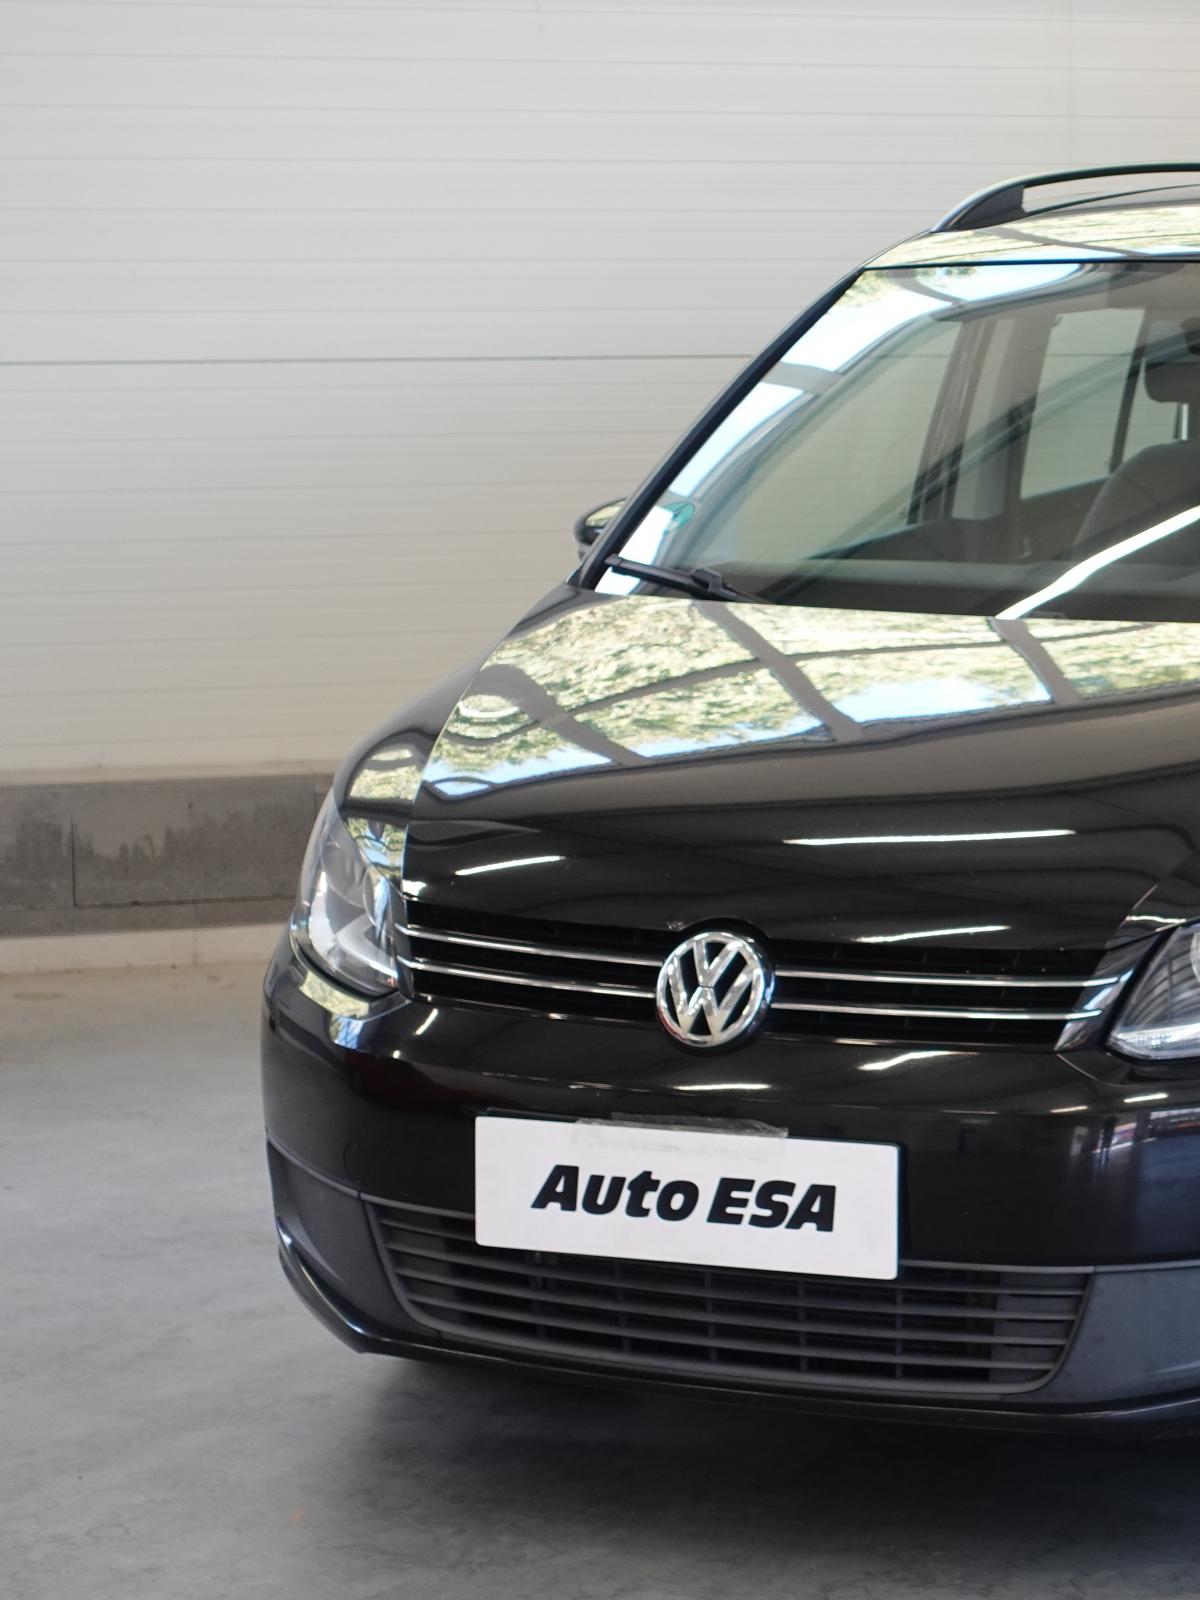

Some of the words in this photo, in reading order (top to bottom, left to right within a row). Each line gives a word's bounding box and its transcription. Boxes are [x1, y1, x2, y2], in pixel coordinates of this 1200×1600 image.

[658, 933, 764, 1045] VW
[531, 1164, 700, 1222] Auto
[706, 1177, 837, 1233] ESA
